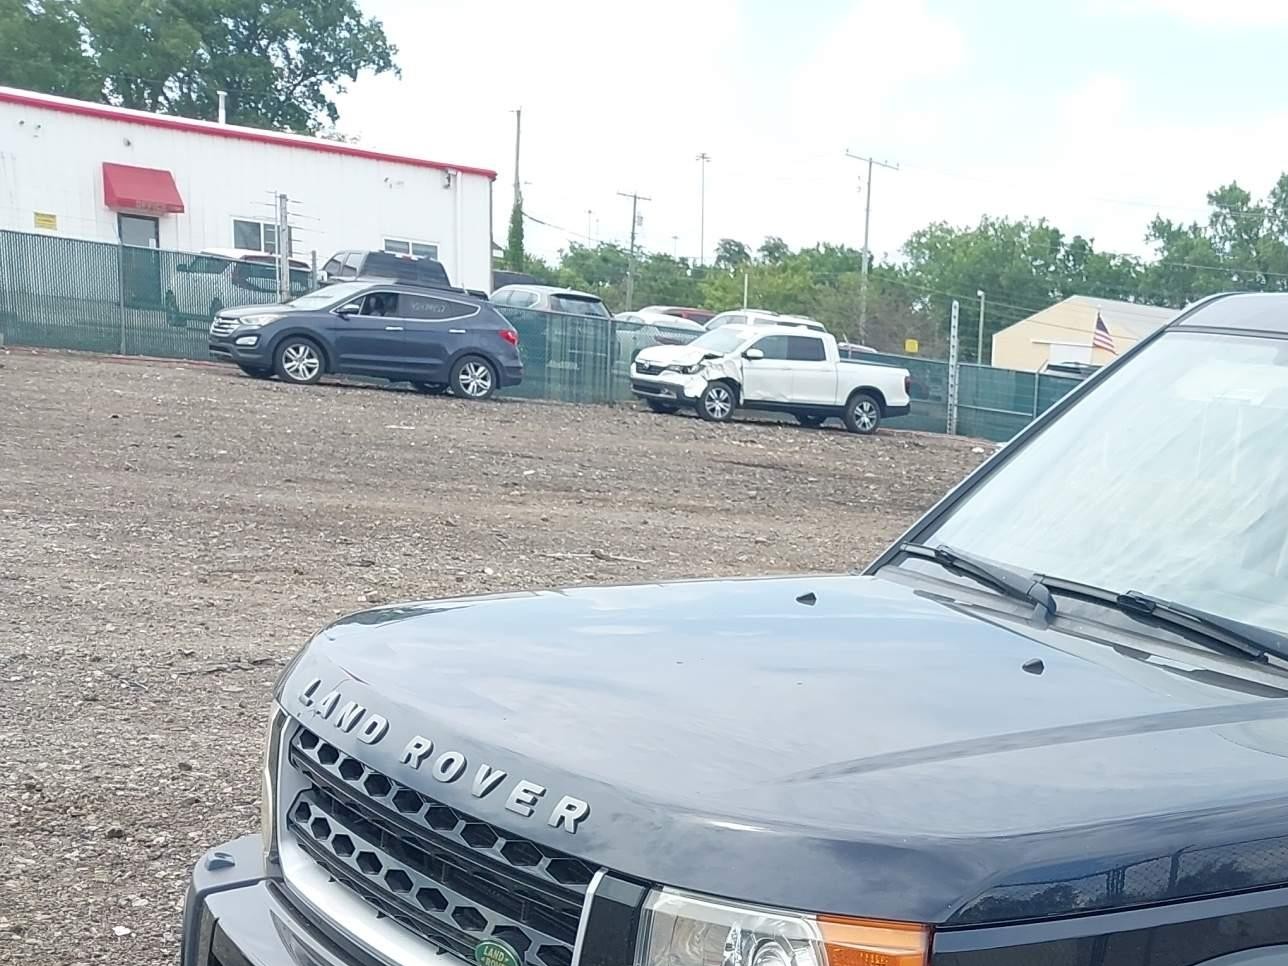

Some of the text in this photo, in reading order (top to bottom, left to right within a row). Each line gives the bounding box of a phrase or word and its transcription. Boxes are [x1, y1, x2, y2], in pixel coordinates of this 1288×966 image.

[299, 678, 590, 834] LAND ROVER
[483, 945, 505, 962] LAND
